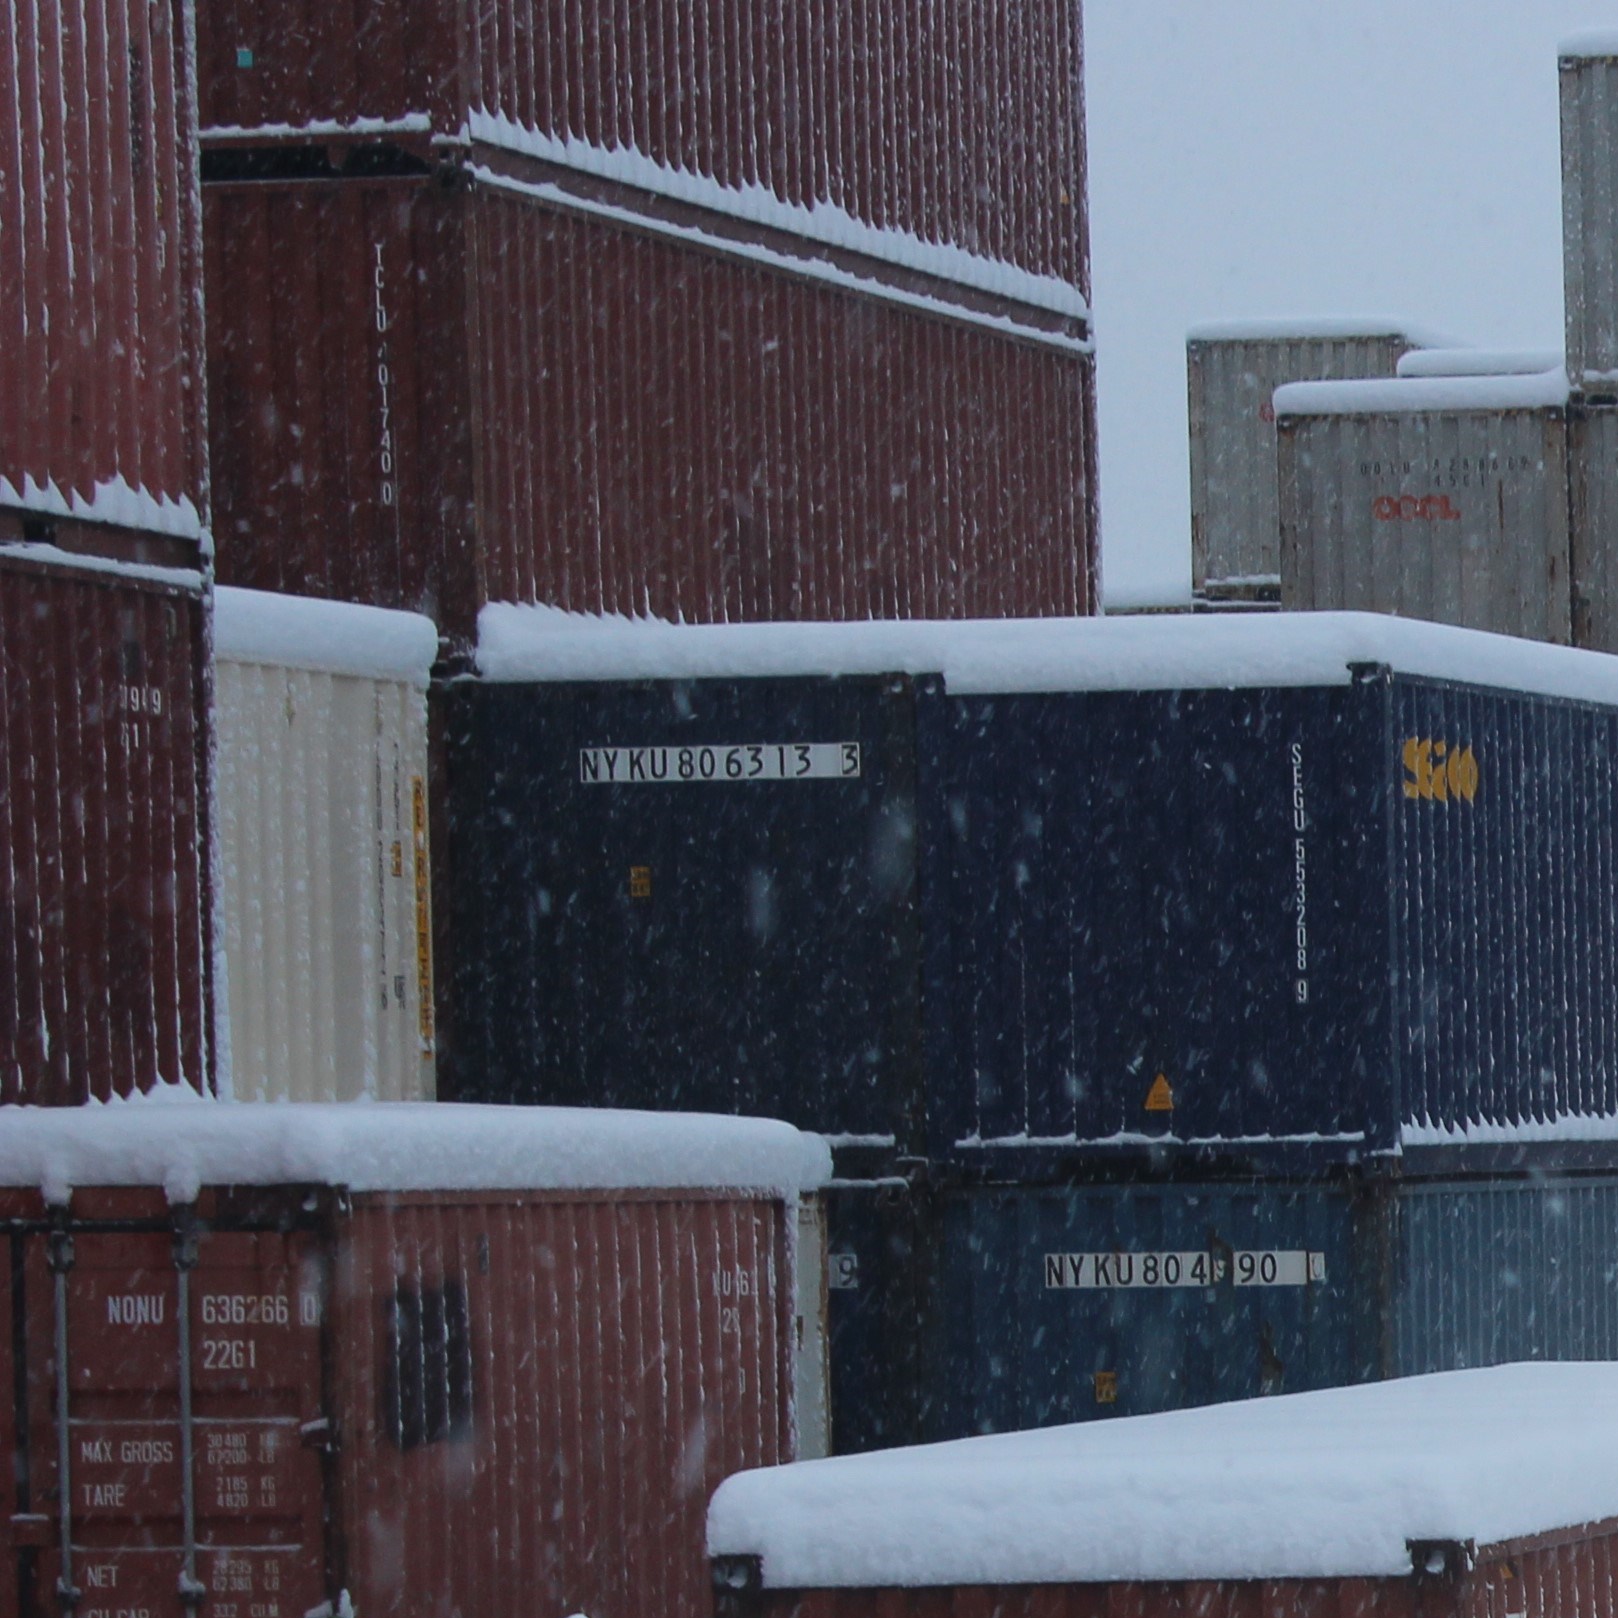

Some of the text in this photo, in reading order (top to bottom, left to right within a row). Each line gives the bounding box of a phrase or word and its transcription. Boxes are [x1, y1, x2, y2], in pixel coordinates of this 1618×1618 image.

[108, 1295, 165, 1325] NONU
[202, 1294, 288, 1325] 636266
[203, 1339, 256, 1369] 22G1
[81, 1441, 174, 1463] MAX GROSS
[83, 1483, 126, 1507] TARE
[87, 1565, 119, 1588] NET
